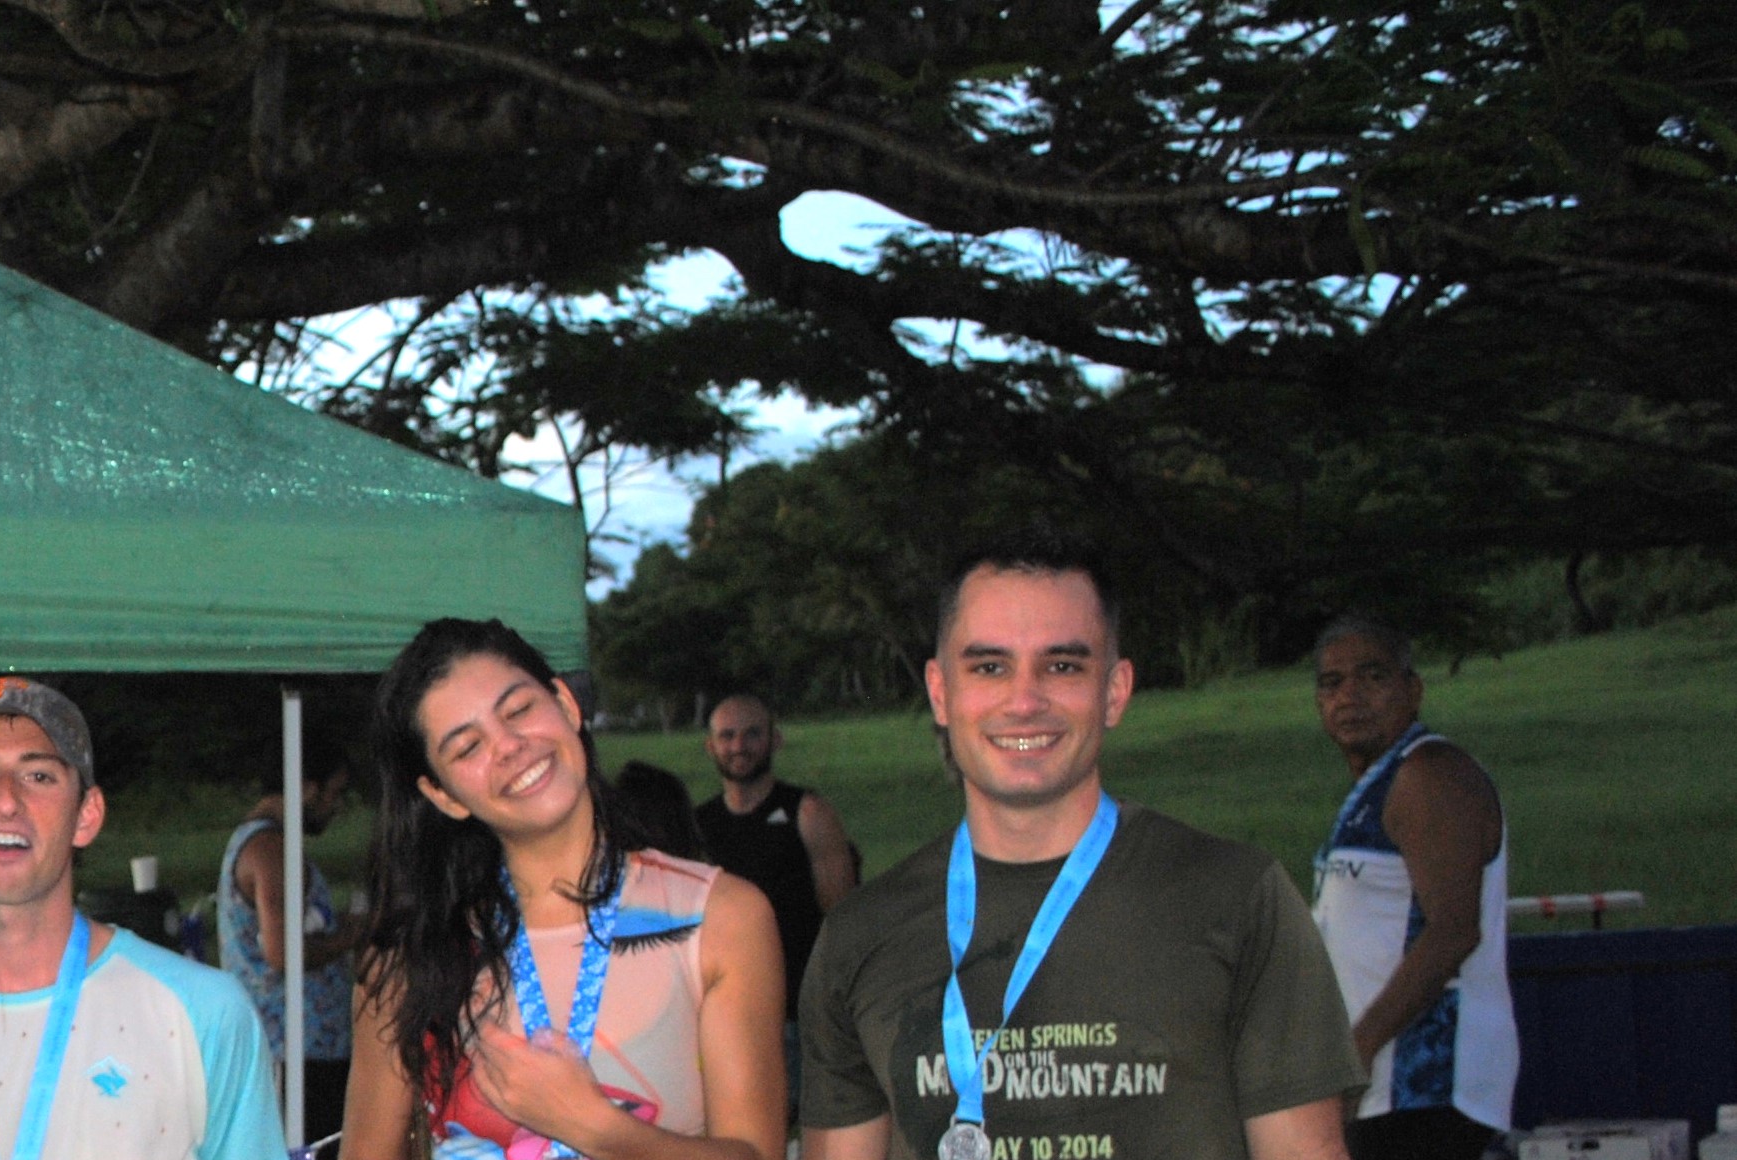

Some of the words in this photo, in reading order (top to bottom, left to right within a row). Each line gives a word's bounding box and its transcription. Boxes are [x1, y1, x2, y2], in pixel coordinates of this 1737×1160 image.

[971, 1027, 1025, 1051] EVEN
[1031, 1023, 1117, 1047] SPRINGS
[1004, 1051, 1027, 1070] ON
[1030, 1049, 1056, 1069] THE
[916, 1051, 1004, 1097] MD
[1006, 1062, 1167, 1100] MOUNTAIN
[1030, 1136, 1053, 1160] 10
[1059, 1134, 1113, 1160] 2014
